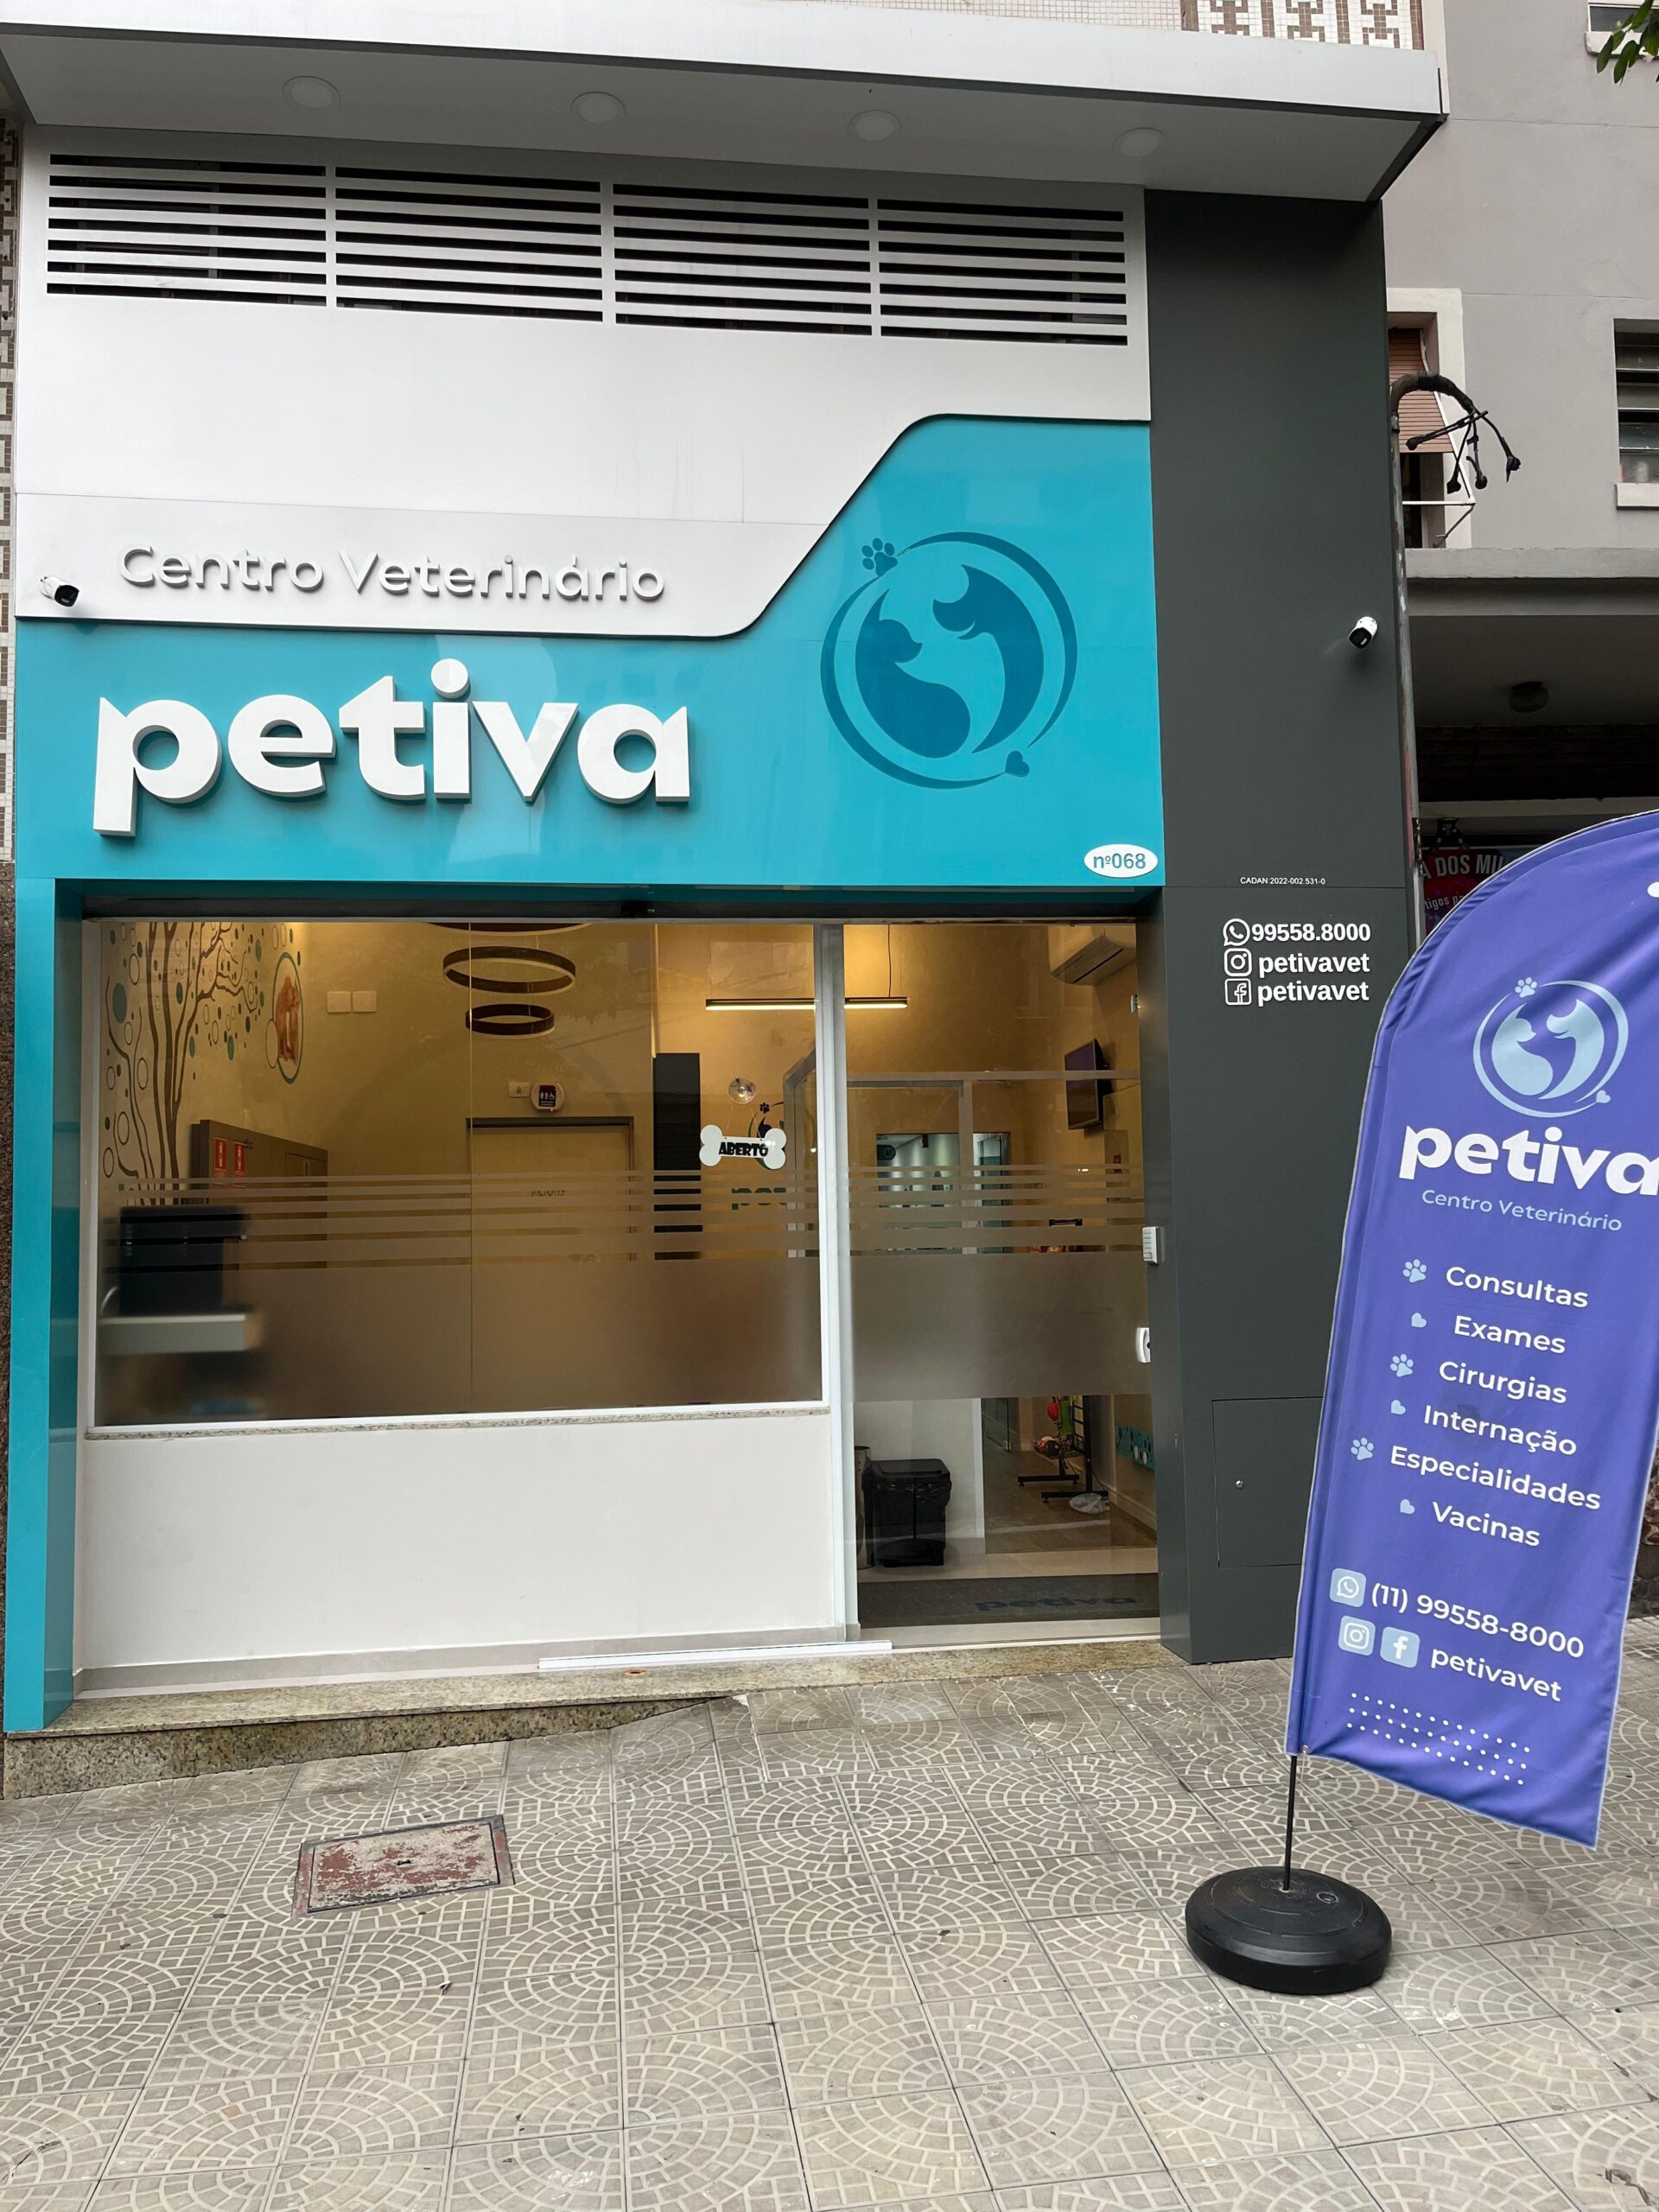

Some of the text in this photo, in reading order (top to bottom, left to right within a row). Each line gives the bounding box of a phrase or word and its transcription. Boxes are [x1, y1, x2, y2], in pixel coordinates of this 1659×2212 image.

[118, 544, 664, 602] Centro Veterinário
[92, 658, 690, 837] petiva
[1434, 855, 1471, 877] DOS
[1424, 897, 1450, 910] tigos
[1252, 923, 1371, 942] 99558.8000
[1258, 952, 1371, 979] petivavet
[1257, 980, 1370, 1007] petivavet
[718, 1141, 769, 1157] ABERTO
[1399, 1125, 1659, 1196] petiva
[1421, 1189, 1623, 1231] Centro Veterinário
[1446, 1266, 1589, 1308] Consultas
[1454, 1314, 1567, 1354] Exames
[1439, 1361, 1567, 1404] Cirurgias
[1424, 1405, 1577, 1456] Internação
[1390, 1445, 1601, 1510] Especialidades
[1432, 1501, 1541, 1547] Vacinas
[1371, 1582, 1585, 1658] (11) 99558-8000
[1431, 1648, 1562, 1702] petivavet
